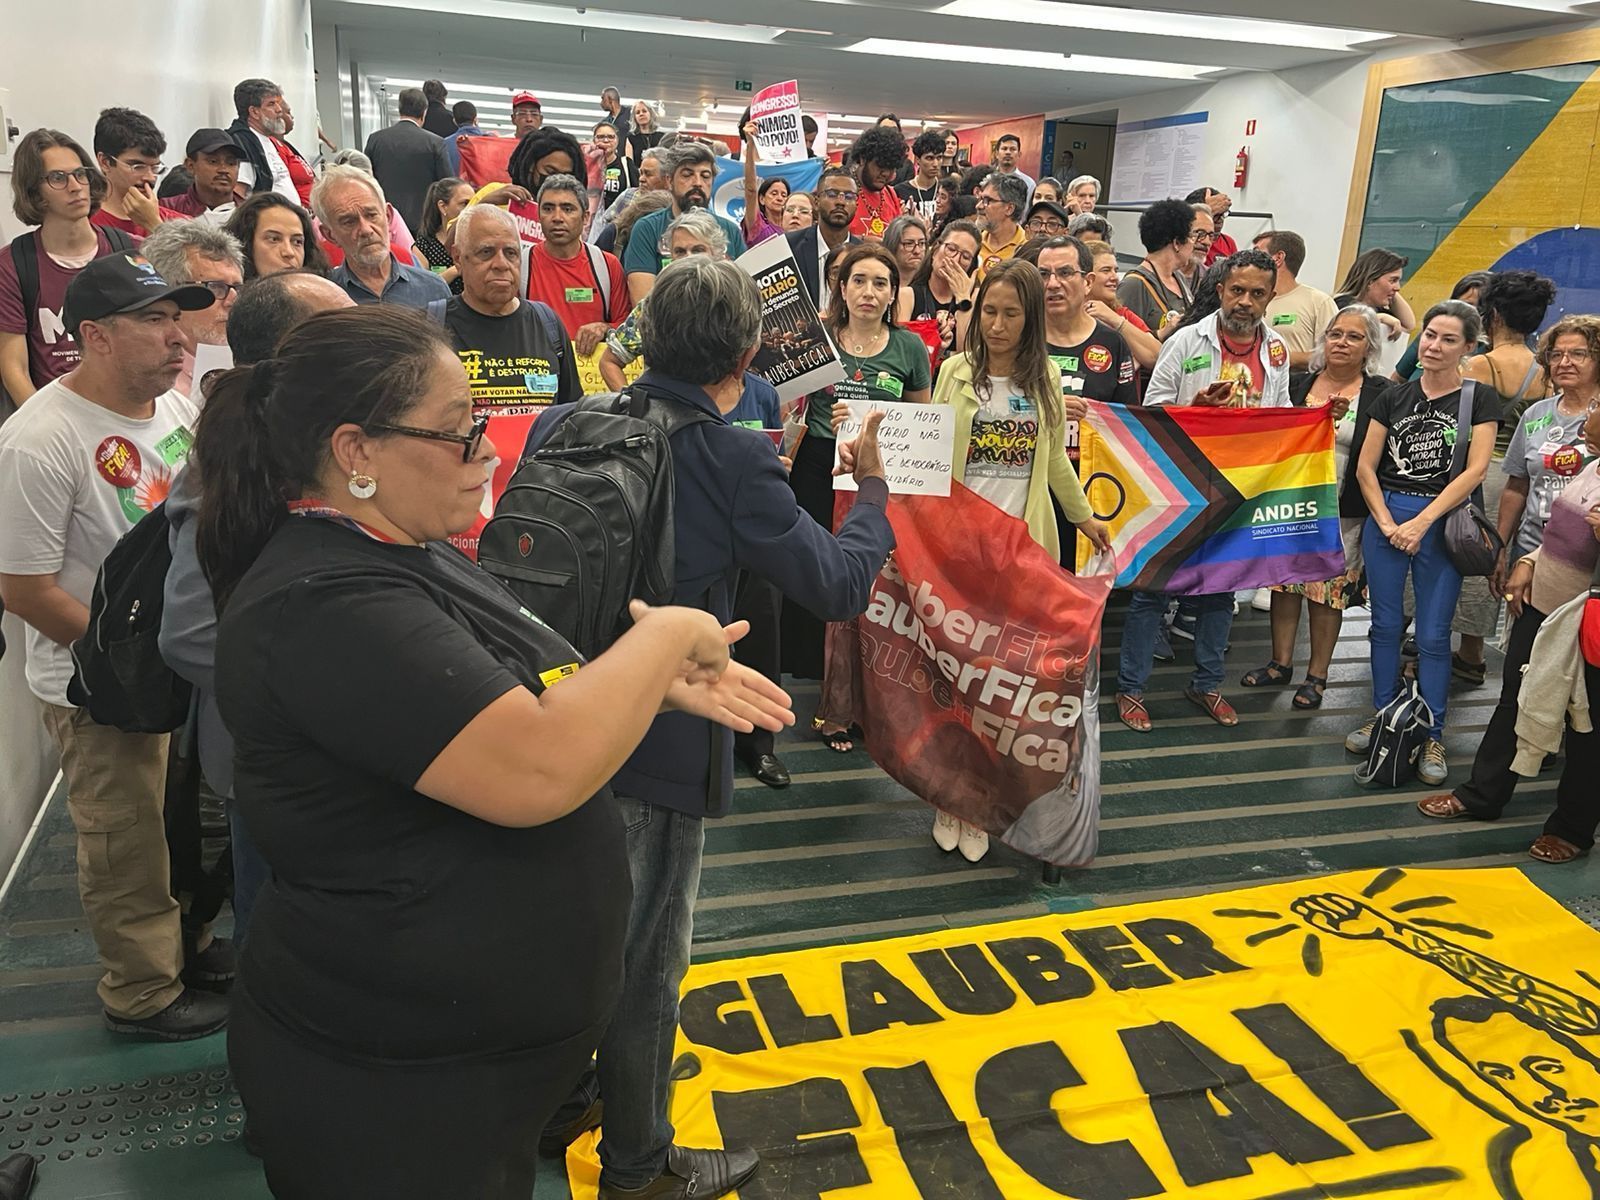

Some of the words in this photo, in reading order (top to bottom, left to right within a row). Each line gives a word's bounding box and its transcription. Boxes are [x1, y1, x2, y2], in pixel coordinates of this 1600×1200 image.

[757, 113, 797, 134] NIMIGO
[771, 130, 800, 147] POVO!
[604, 179, 620, 192] ME!
[761, 276, 798, 300] TARIO
[772, 295, 800, 310] Secreto
[484, 358, 505, 367] NÃO
[516, 358, 551, 367] REFORMA
[759, 359, 800, 385] AUBER
[797, 344, 830, 371] FICA!
[834, 384, 869, 394] generosa,
[850, 392, 870, 400] quem
[920, 429, 940, 440] NÃO
[1406, 431, 1436, 444] CONTRA
[1410, 450, 1437, 462] MORAL
[1438, 448, 1443, 457] E
[1251, 501, 1318, 523] ANDES
[1251, 527, 1285, 536] SINDICATO
[1286, 523, 1318, 532] NACIONAL
[865, 589, 1082, 729] auberFica
[678, 917, 1254, 1056] GLAUBER
[711, 1003, 1435, 1200] FICA!
